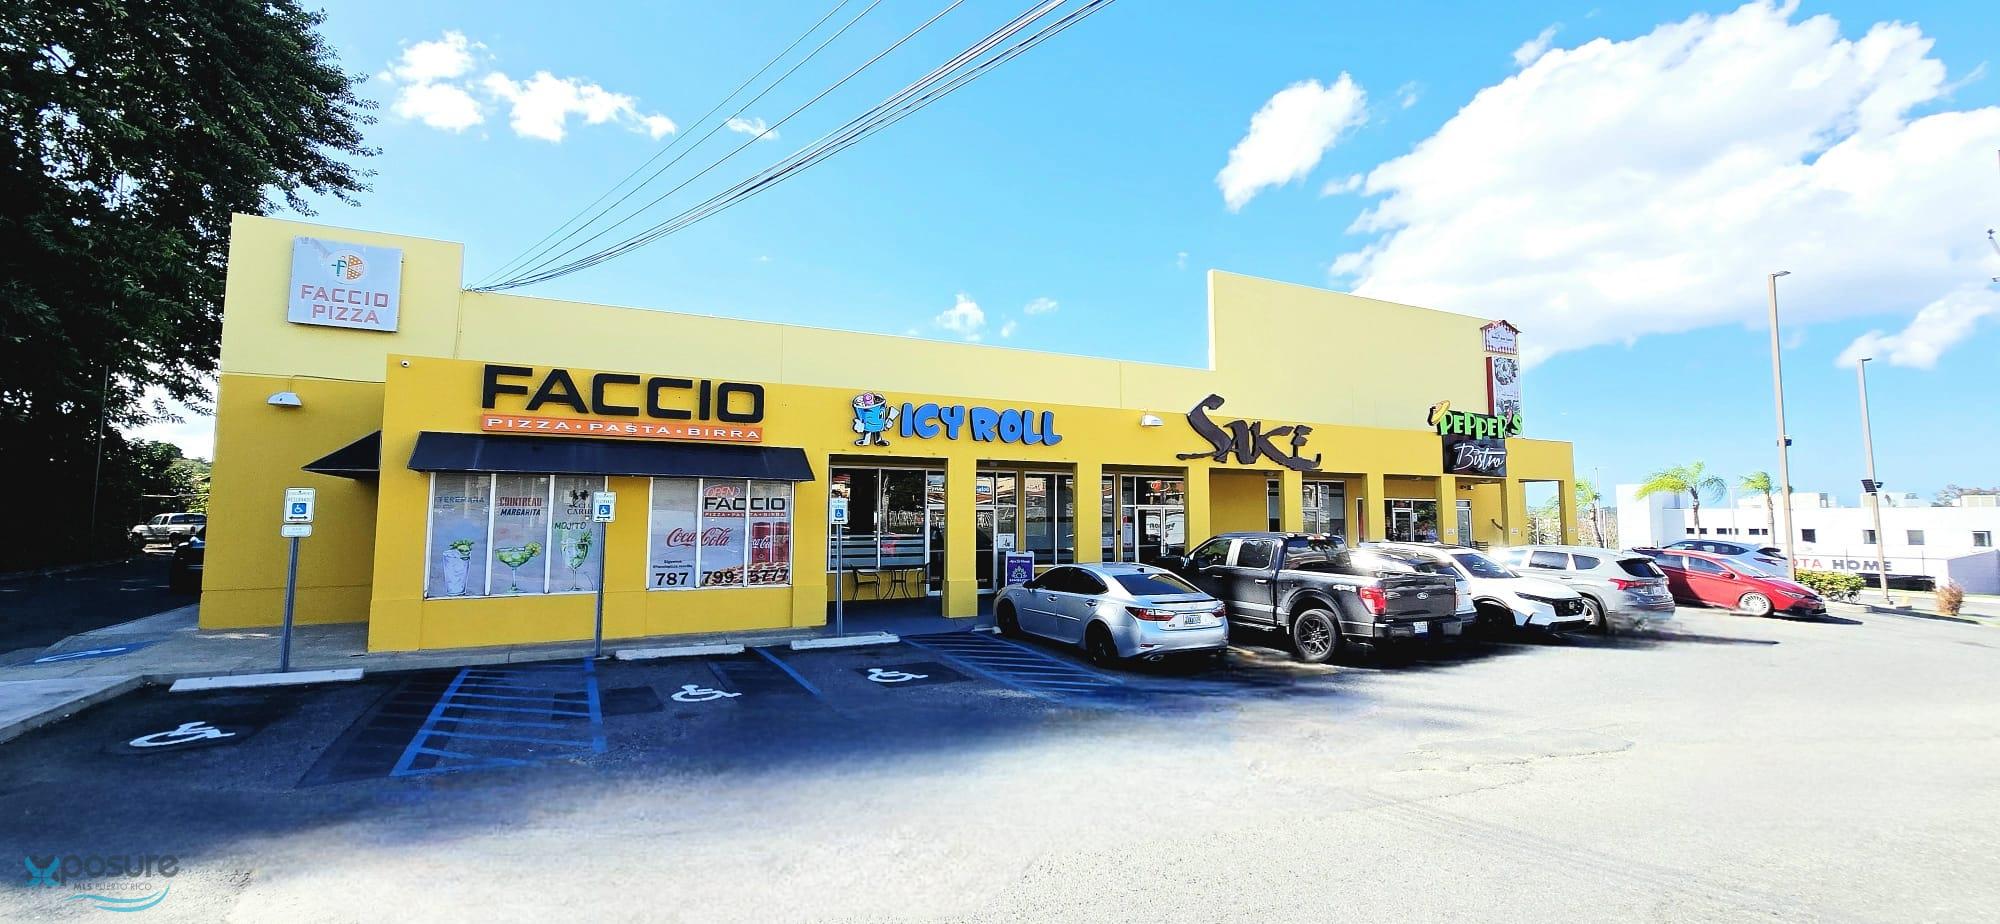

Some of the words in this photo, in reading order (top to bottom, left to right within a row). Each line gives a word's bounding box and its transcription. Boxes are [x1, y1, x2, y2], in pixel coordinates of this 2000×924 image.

[300, 284, 389, 308] FACCIO
[312, 304, 380, 324] PIZZA
[482, 363, 765, 424] FACCIO
[486, 417, 570, 431] PIZZA
[589, 421, 671, 435] PASTA
[687, 427, 760, 440] BIRRA
[900, 402, 965, 440] ICY
[969, 406, 1063, 446] ROLL
[1176, 393, 1323, 472] SAKE
[1453, 442, 1506, 471] Bistro
[499, 496, 542, 507] COINTREAU
[704, 496, 786, 510] FACCIO
[500, 508, 541, 516] MARGARITA
[554, 521, 587, 530] MOJITO
[1832, 559, 1893, 572] HOME
[655, 572, 689, 585] 787
